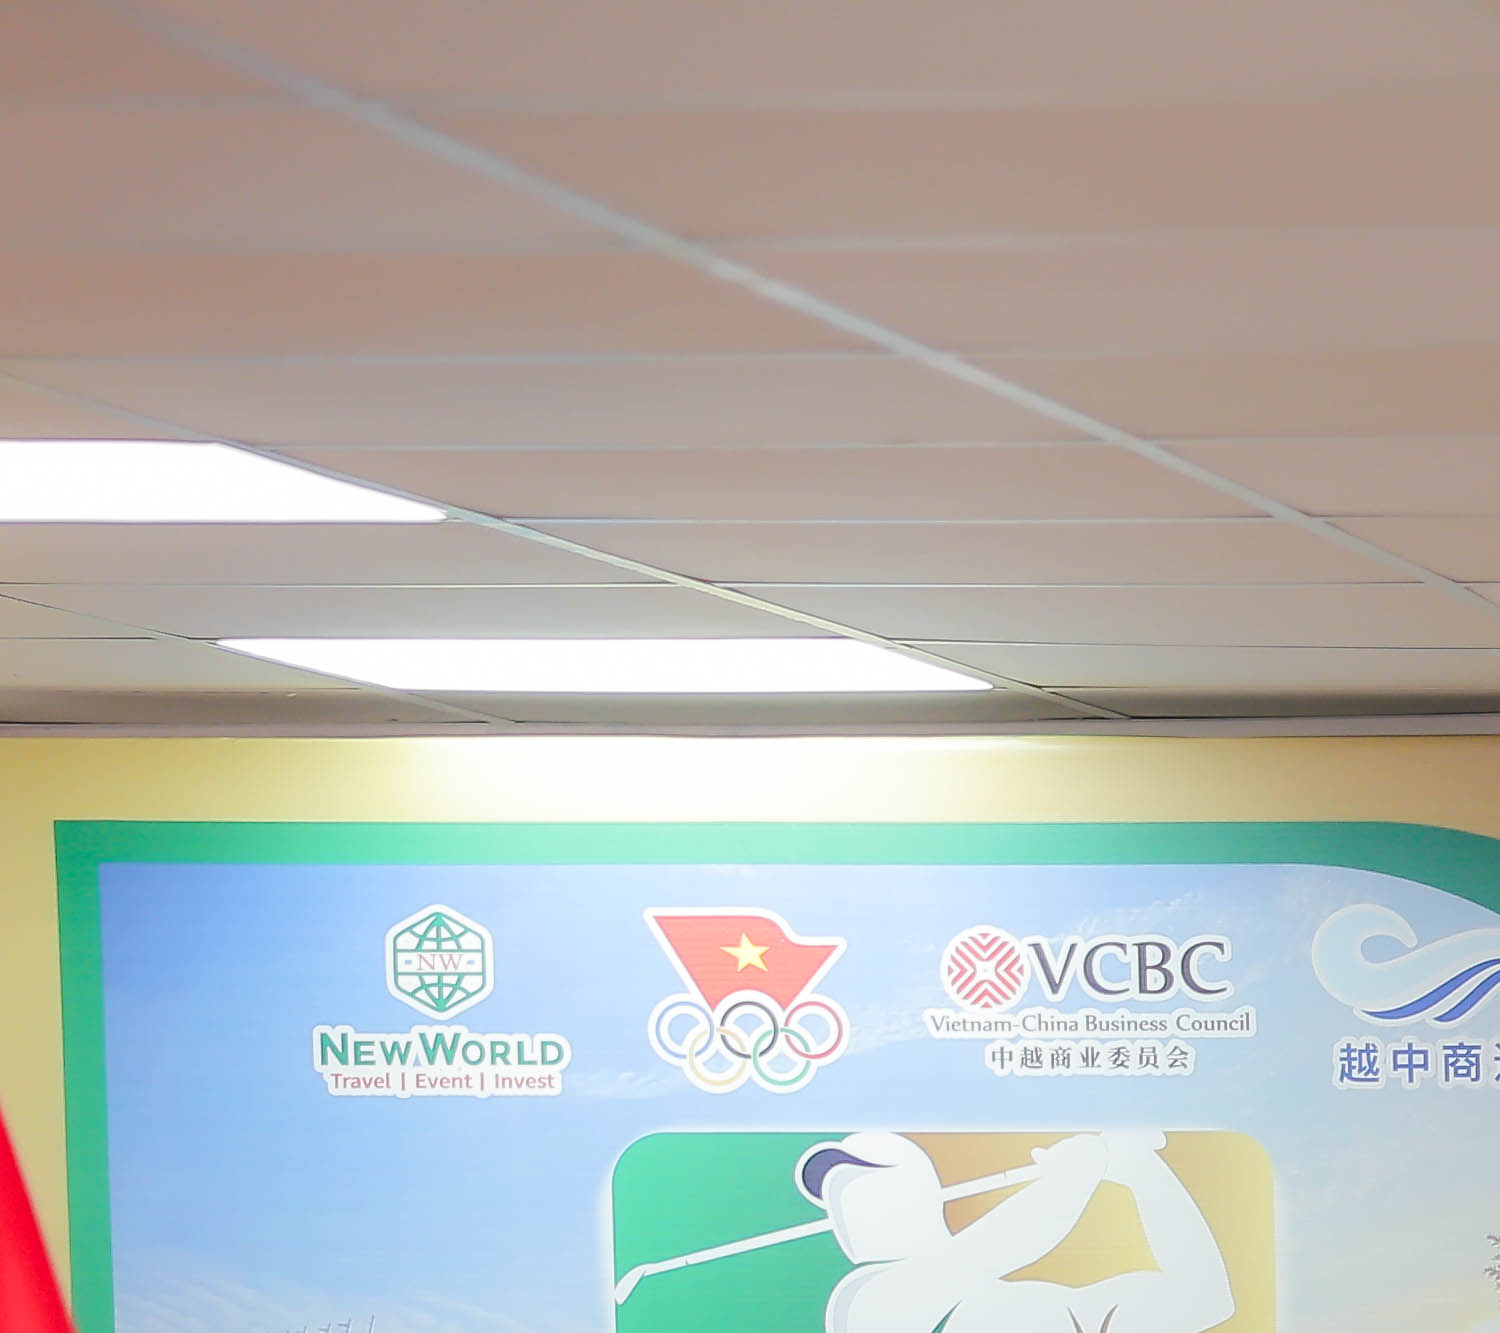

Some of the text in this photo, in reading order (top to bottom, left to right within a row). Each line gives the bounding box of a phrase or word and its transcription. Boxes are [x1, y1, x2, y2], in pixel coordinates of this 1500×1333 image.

[416, 952, 463, 972] NW
[1028, 941, 1230, 995] VCBC
[930, 1012, 1250, 1034] Vietnam-China Business Council
[991, 1044, 1190, 1070] 中越商业委员会
[330, 1070, 555, 1089] Travel Event Invest
